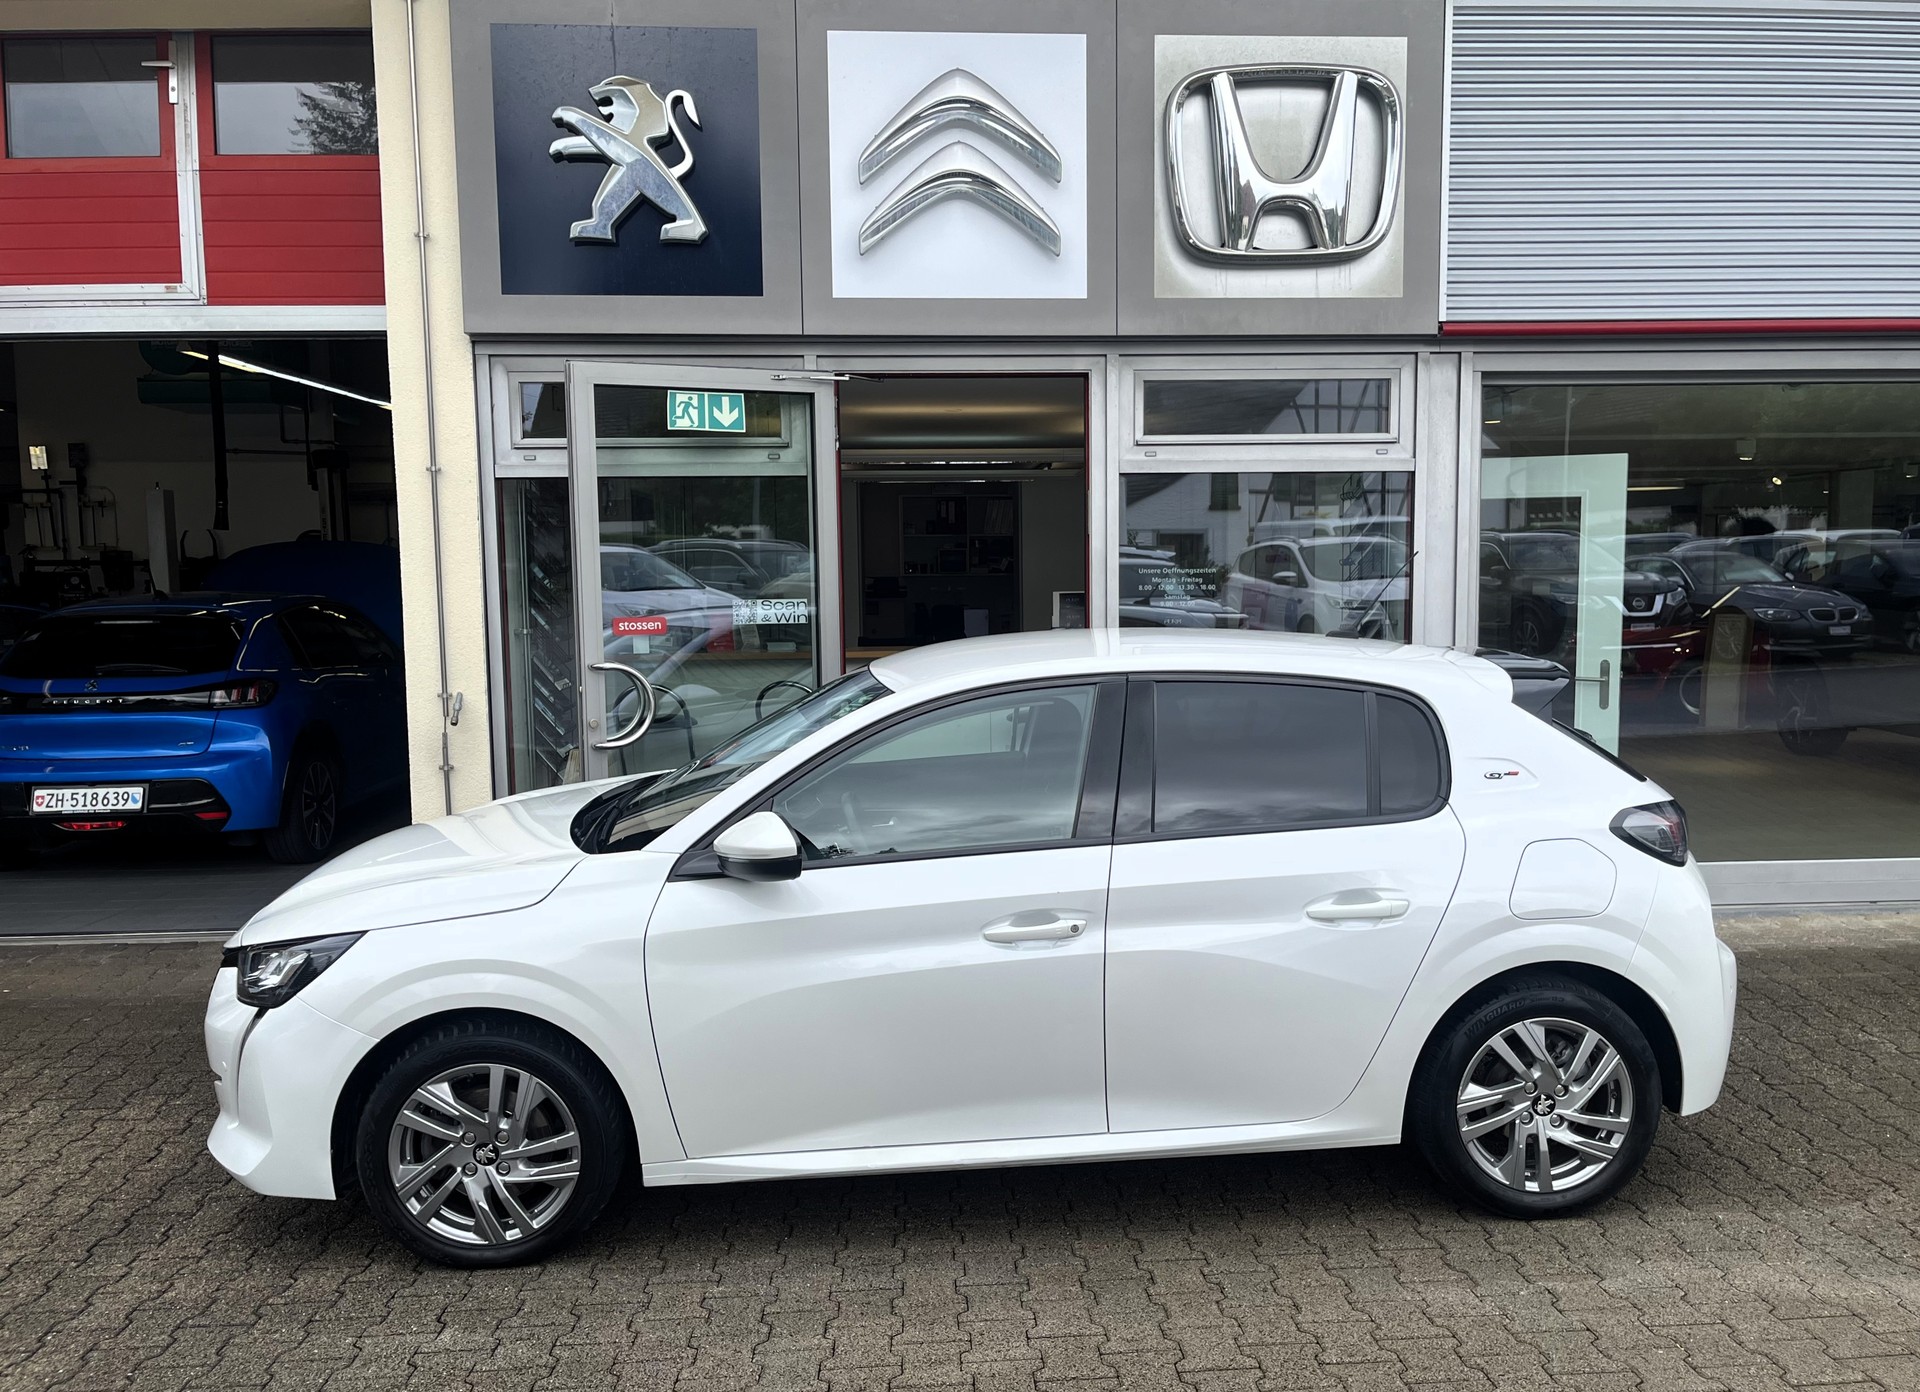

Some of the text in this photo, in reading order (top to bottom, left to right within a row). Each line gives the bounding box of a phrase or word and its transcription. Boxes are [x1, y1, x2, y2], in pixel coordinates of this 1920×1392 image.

[1162, 568, 1217, 576] Oeffnungszeiten
[1151, 576, 1176, 584] Montag
[1181, 576, 1203, 584] Freitag
[760, 600, 807, 611] Scan
[761, 611, 808, 623] & Win
[618, 620, 662, 632] stossen
